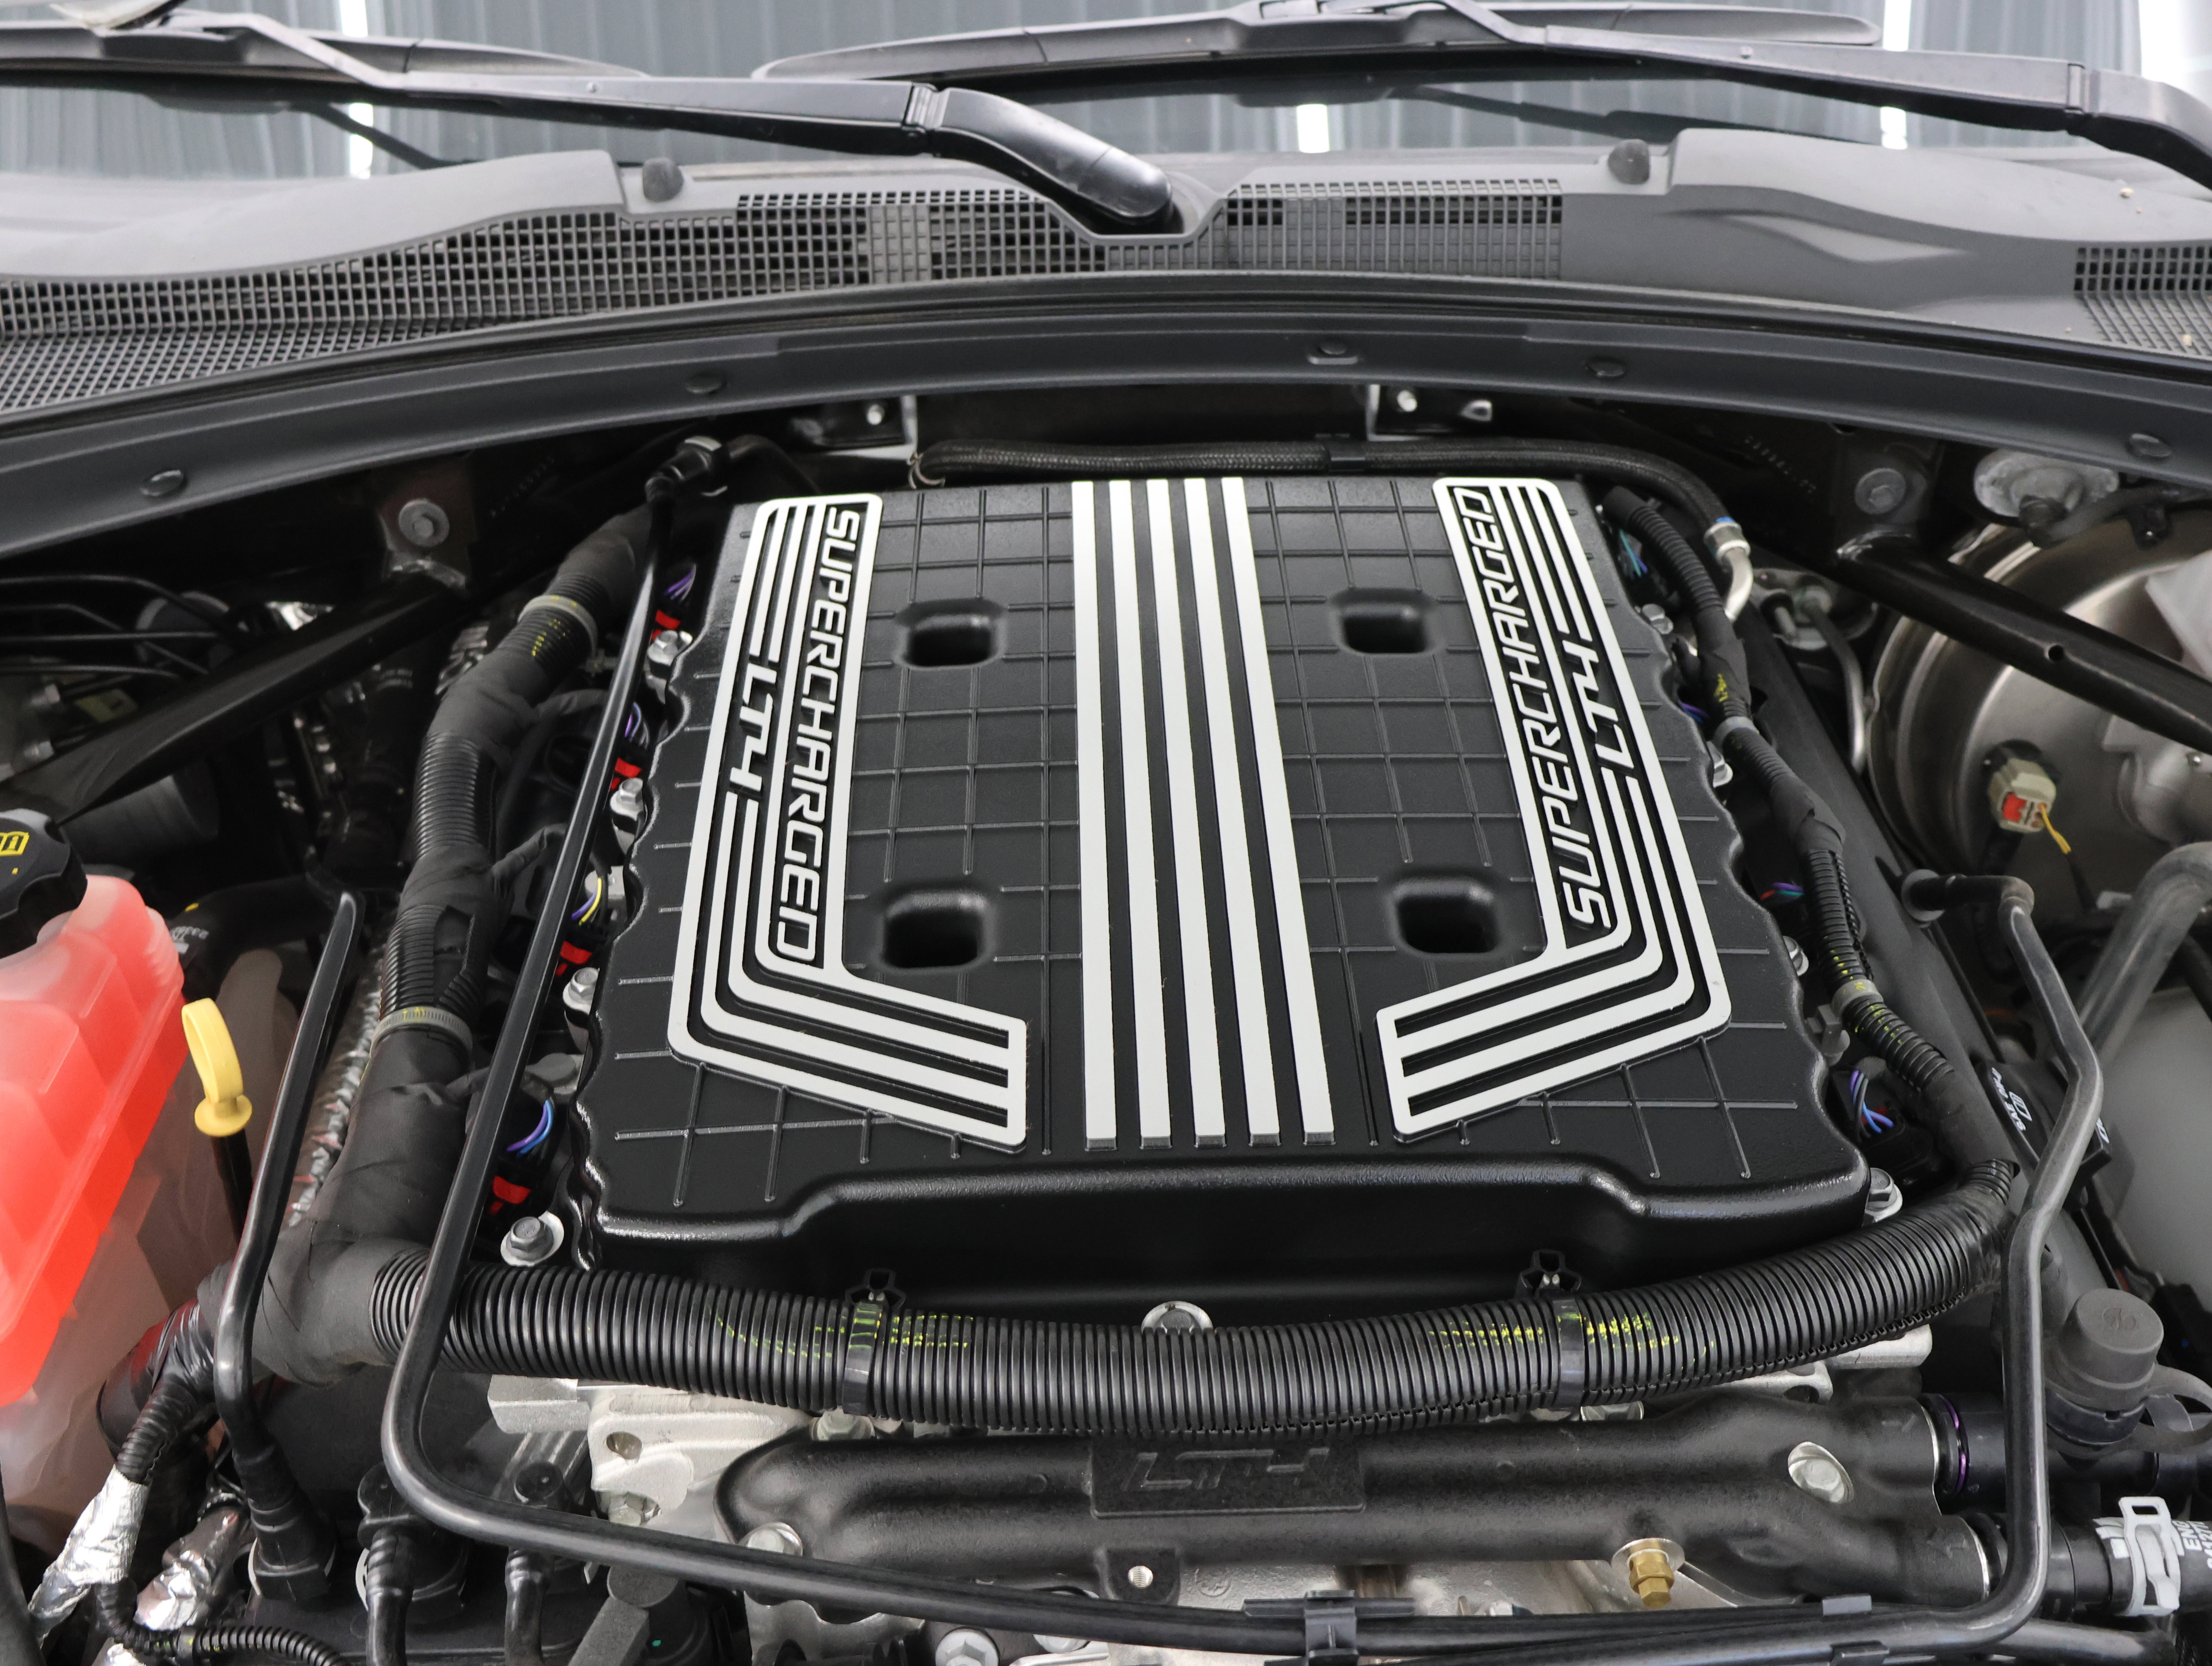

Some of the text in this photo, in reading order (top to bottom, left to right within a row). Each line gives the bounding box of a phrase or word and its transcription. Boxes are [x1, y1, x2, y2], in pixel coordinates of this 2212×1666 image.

[730, 663, 776, 793] LT4
[776, 506, 860, 961] SUPERCHARGED
[1453, 487, 1612, 929] SUPERCHARGED
[1563, 640, 1635, 769] LT4
[1119, 1447, 1329, 1491] LT4
